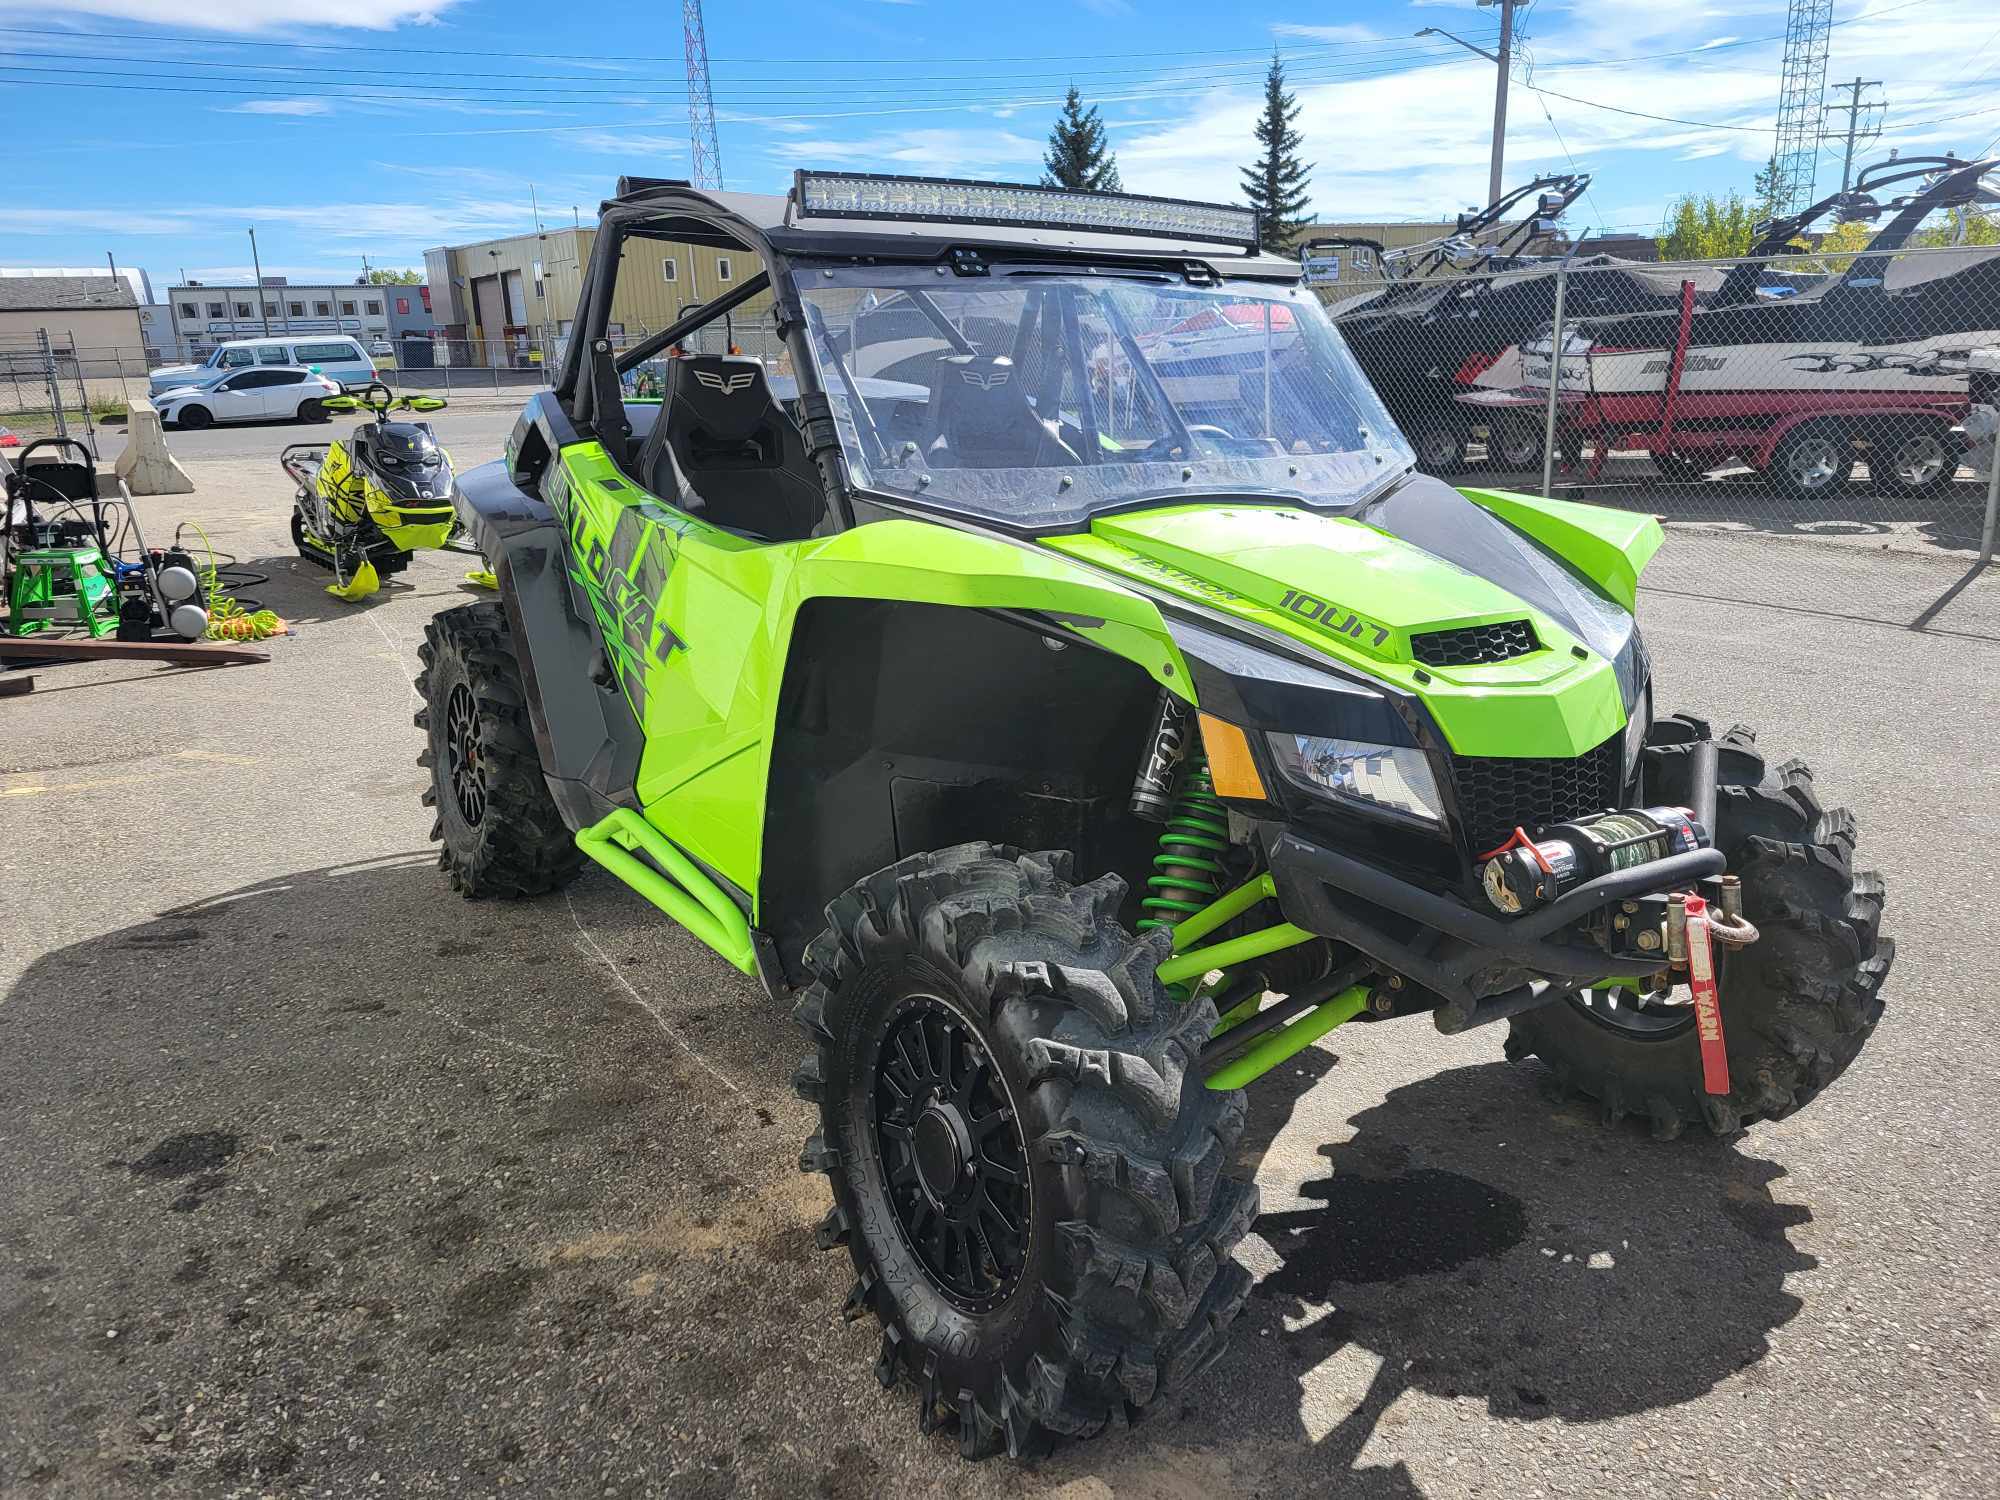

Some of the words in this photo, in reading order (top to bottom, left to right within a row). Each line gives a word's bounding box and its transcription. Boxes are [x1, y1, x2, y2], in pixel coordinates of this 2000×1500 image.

[1640, 355, 1728, 375] mlibu
[1145, 697, 1185, 793] FOX
[1695, 989, 1720, 1041] WARN
